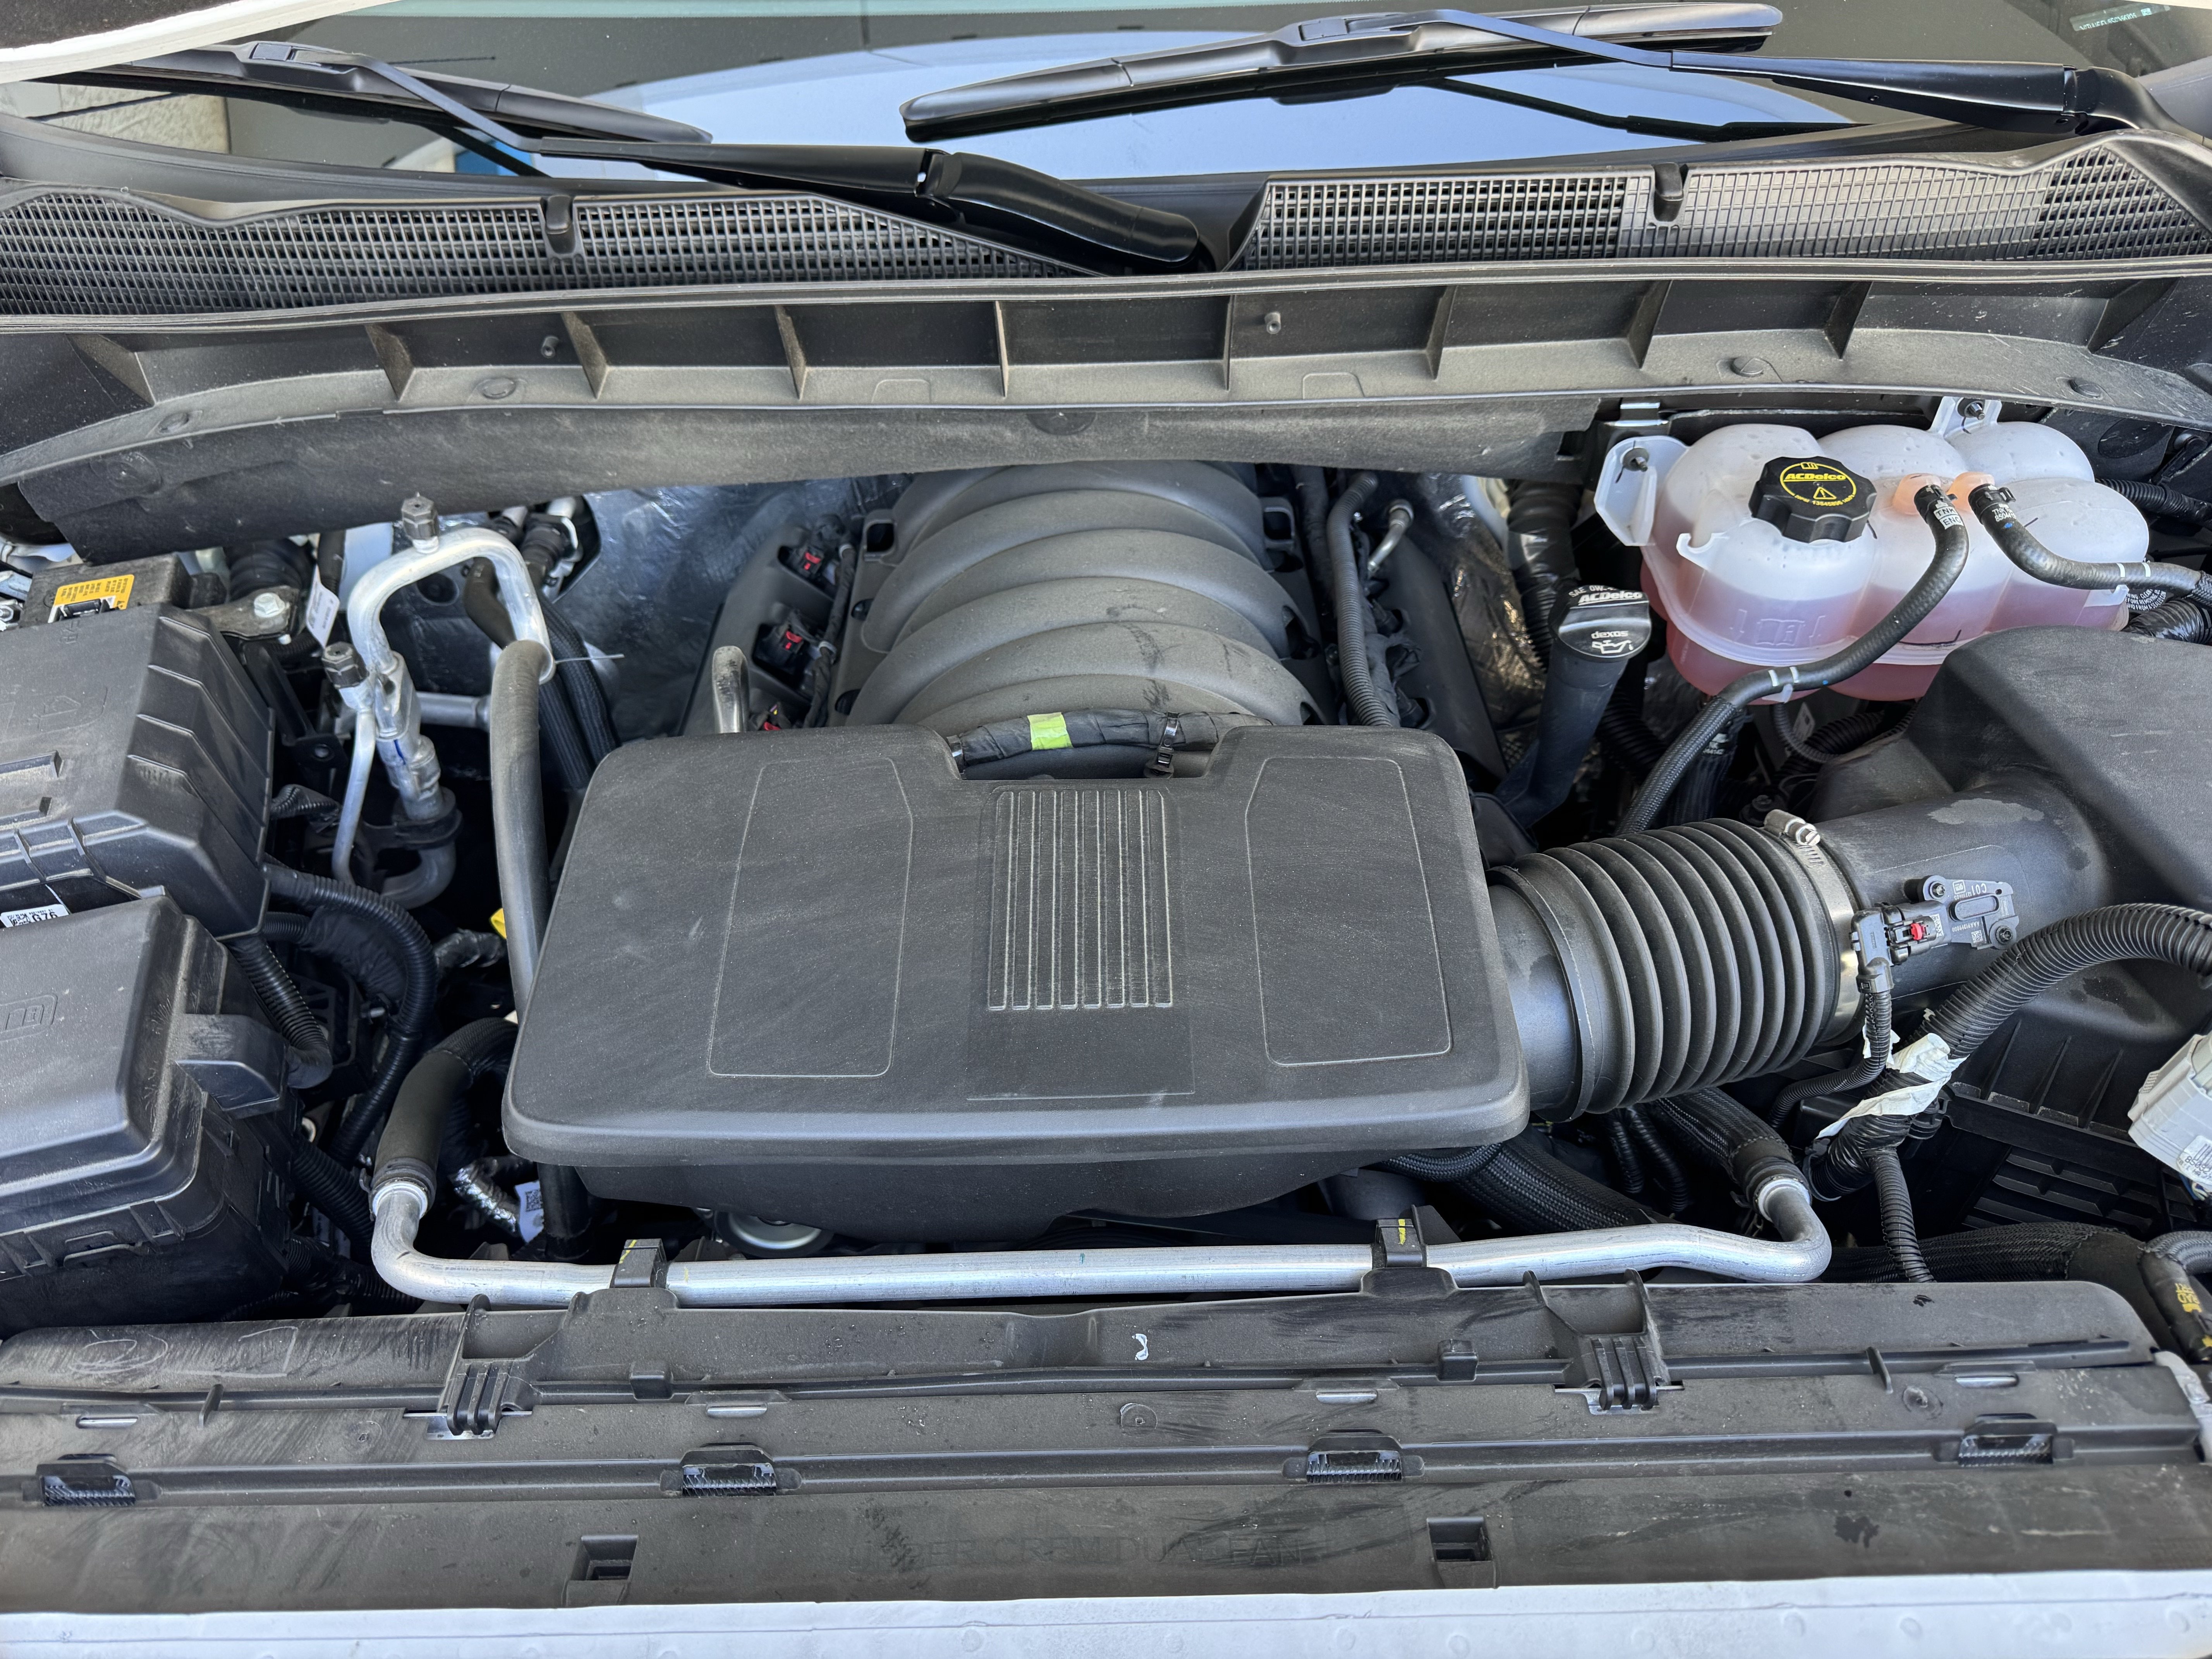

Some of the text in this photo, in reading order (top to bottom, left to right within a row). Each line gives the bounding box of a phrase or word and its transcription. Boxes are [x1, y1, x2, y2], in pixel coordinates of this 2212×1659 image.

[1936, 508, 1956, 516] TNK
[1568, 587, 1587, 598] SAE
[1578, 591, 1643, 603] ACDelco
[1591, 630, 1629, 639] dexos
[1971, 883, 1987, 896] C01
[1229, 1537, 1303, 1565] FAN
